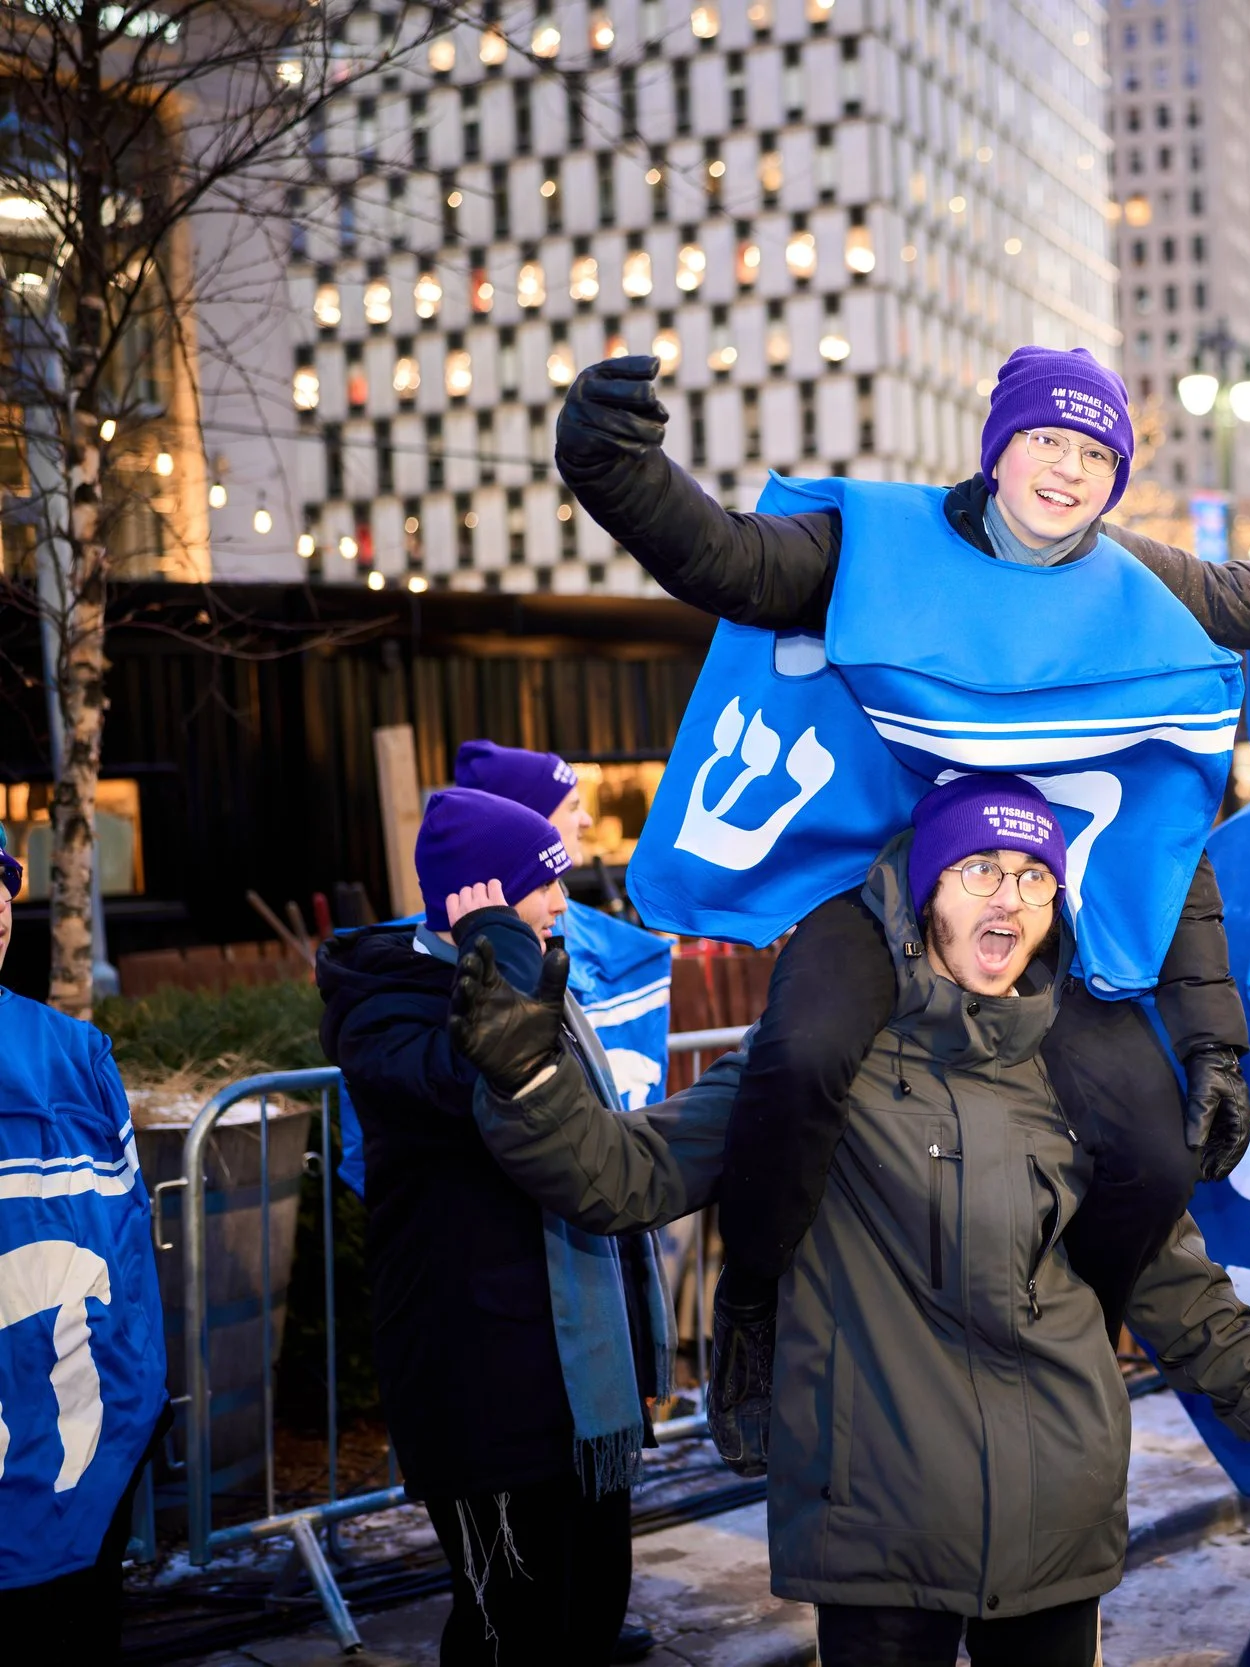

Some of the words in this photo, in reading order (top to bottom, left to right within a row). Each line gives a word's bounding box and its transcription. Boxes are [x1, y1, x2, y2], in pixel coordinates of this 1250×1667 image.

[1051, 388, 1066, 397] AM
[1068, 389, 1102, 409] YISRAEL
[1104, 404, 1119, 421] CHAI
[1055, 400, 1066, 409] חי
[1070, 401, 1100, 419] ישראל
[1102, 416, 1113, 430] עם
[983, 806, 998, 815] AM
[1000, 806, 1036, 822] YISRAEL
[989, 817, 1000, 827] חי
[1004, 817, 1035, 832] ישראל
